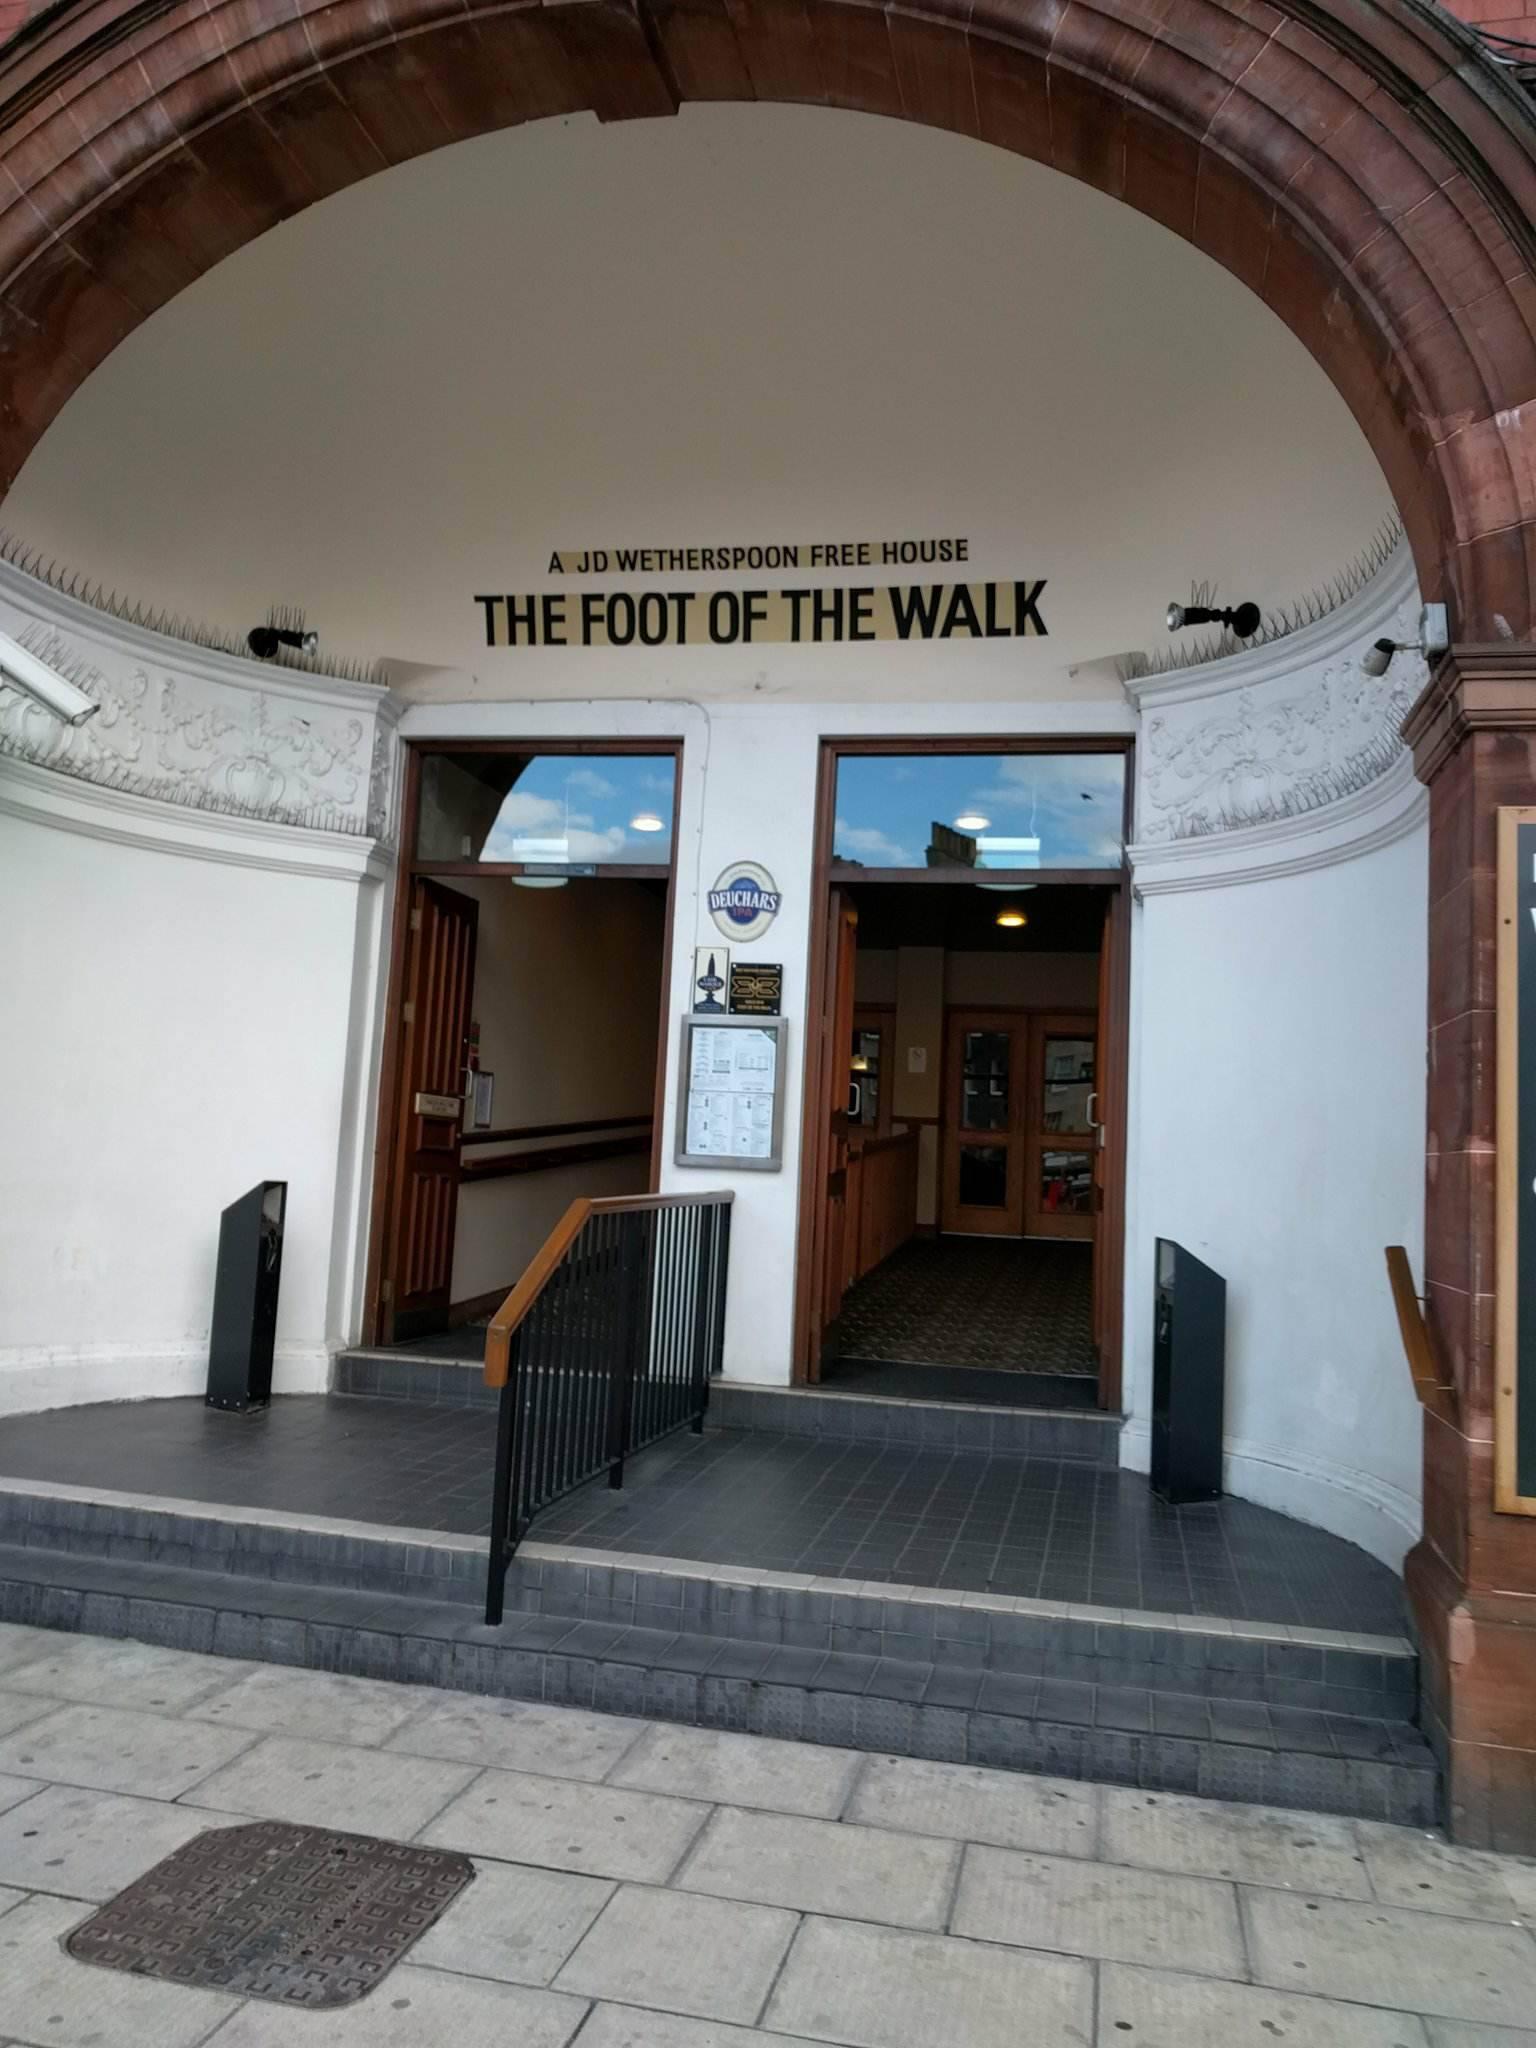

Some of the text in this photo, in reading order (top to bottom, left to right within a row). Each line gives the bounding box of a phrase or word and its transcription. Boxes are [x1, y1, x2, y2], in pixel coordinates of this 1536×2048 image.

[549, 539, 968, 573] A JD WETHERSPOON FREE HOUSE
[474, 580, 1048, 646] THE FOOT OF THE WALK
[710, 890, 777, 911] DEUCHARS
